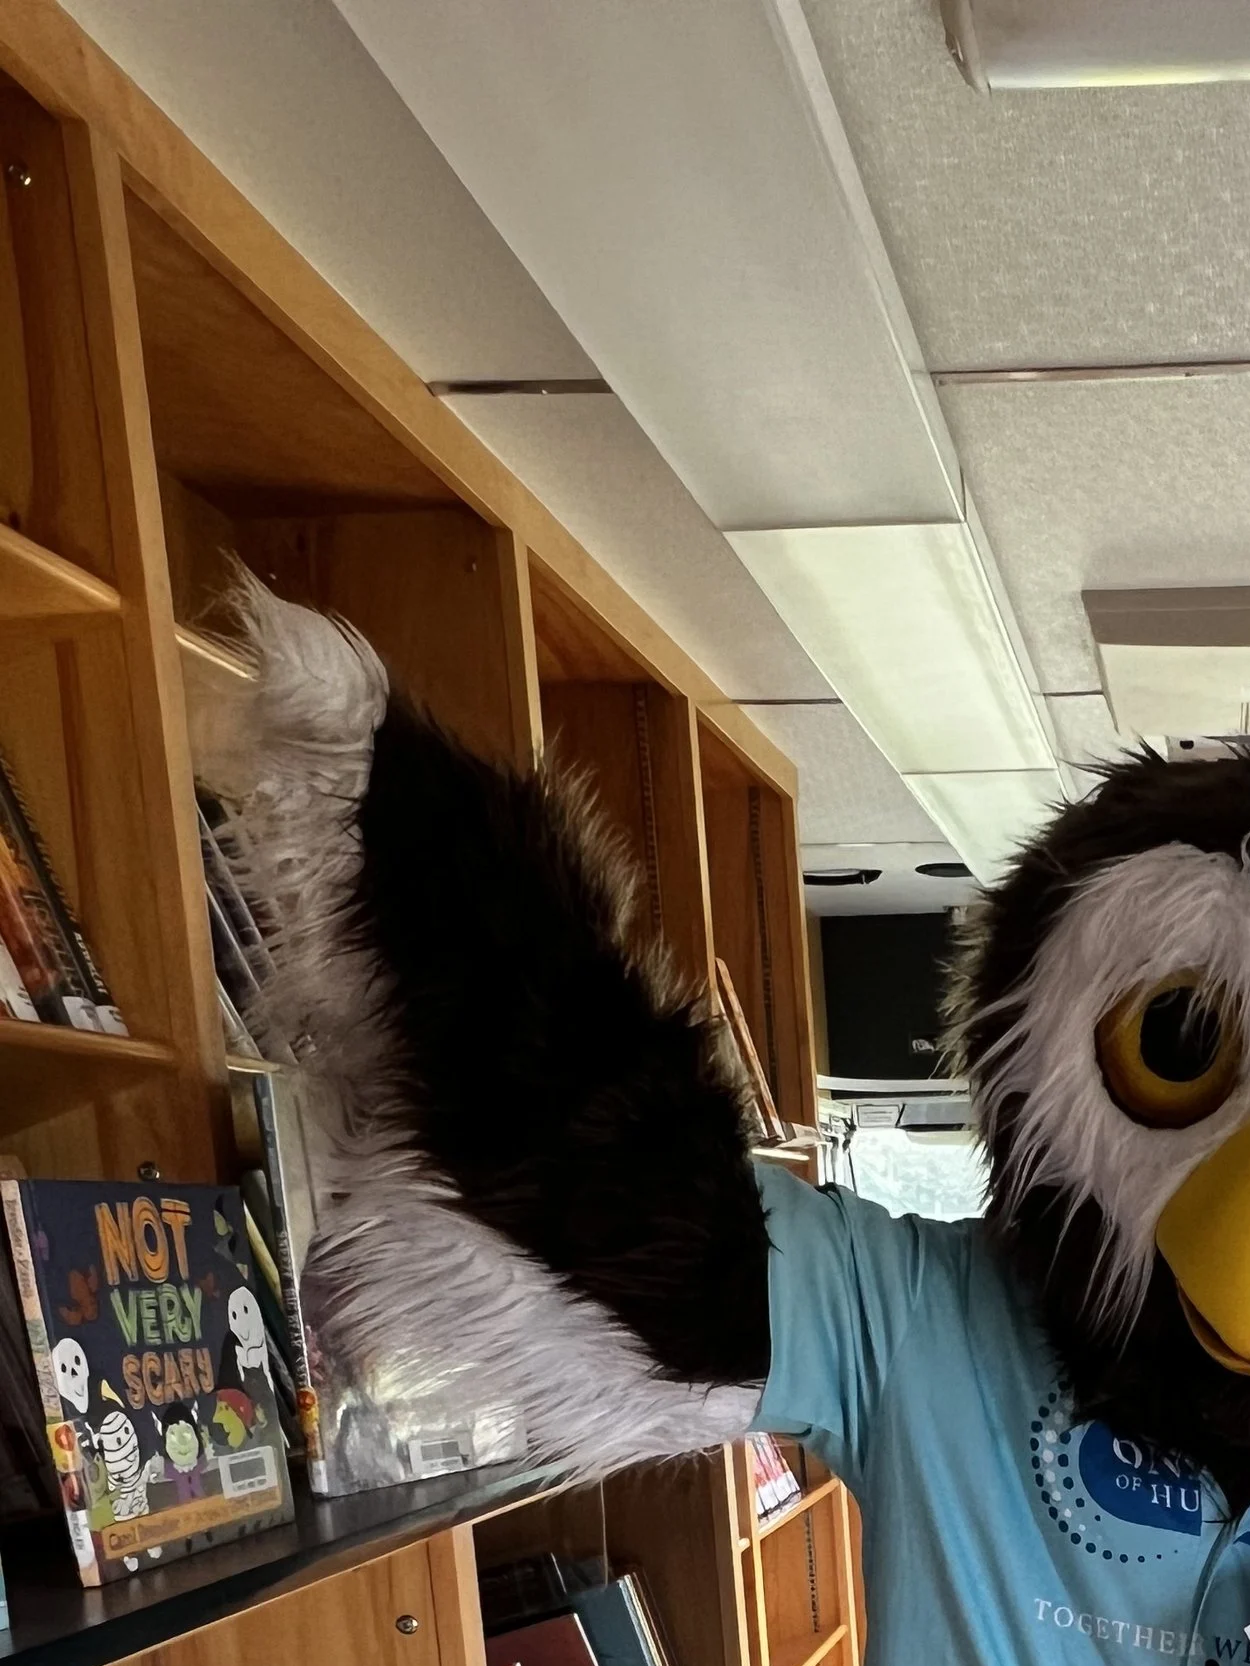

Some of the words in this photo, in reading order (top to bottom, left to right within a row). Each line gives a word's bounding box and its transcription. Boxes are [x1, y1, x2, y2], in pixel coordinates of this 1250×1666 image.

[95, 1196, 192, 1285] NOT
[110, 1283, 202, 1347] VERY
[122, 1348, 215, 1409] SCARY
[1115, 1473, 1142, 1492] OF
[1034, 1598, 1204, 1657] TOGETHER
